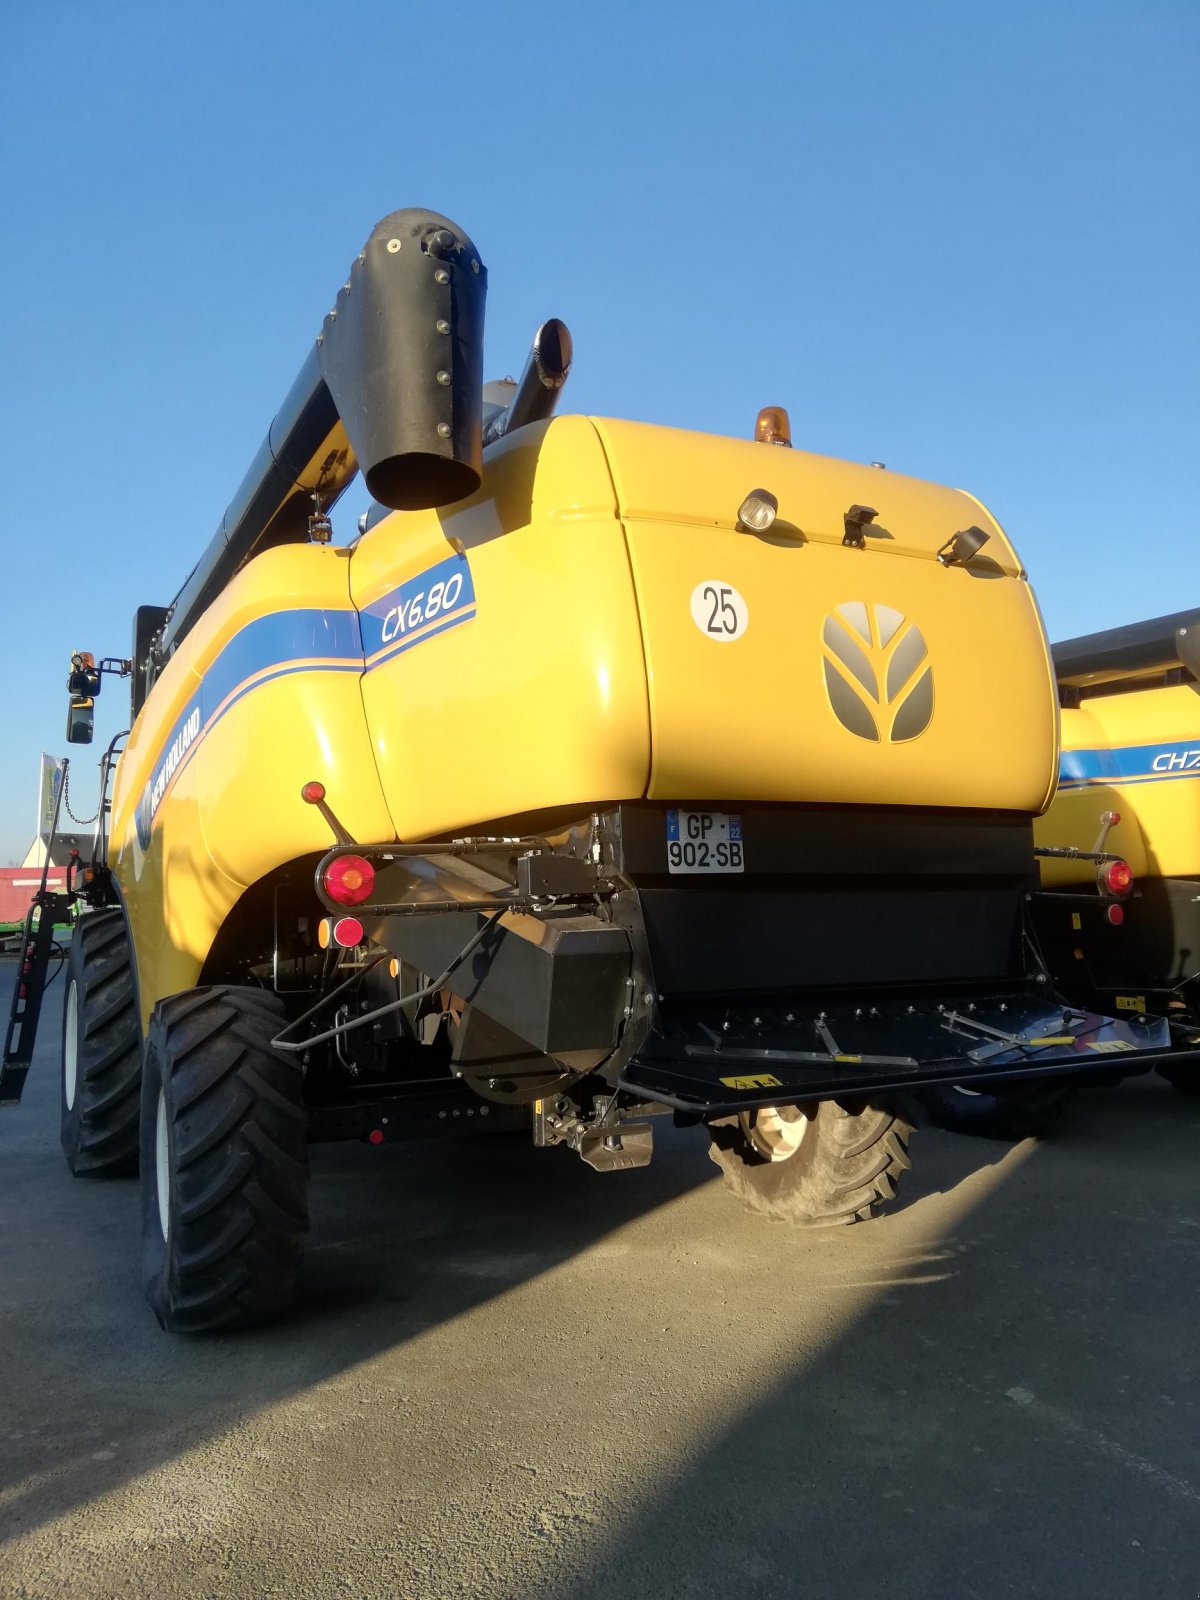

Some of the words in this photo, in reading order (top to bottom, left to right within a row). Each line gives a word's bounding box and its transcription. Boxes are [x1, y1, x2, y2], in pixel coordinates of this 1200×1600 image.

[382, 573, 463, 642] CX6.80
[703, 586, 738, 634] 25
[151, 763, 166, 818] NEW
[165, 706, 200, 784] HOLLAND
[669, 842, 742, 867] 902-SB
[730, 828, 741, 839] 22
